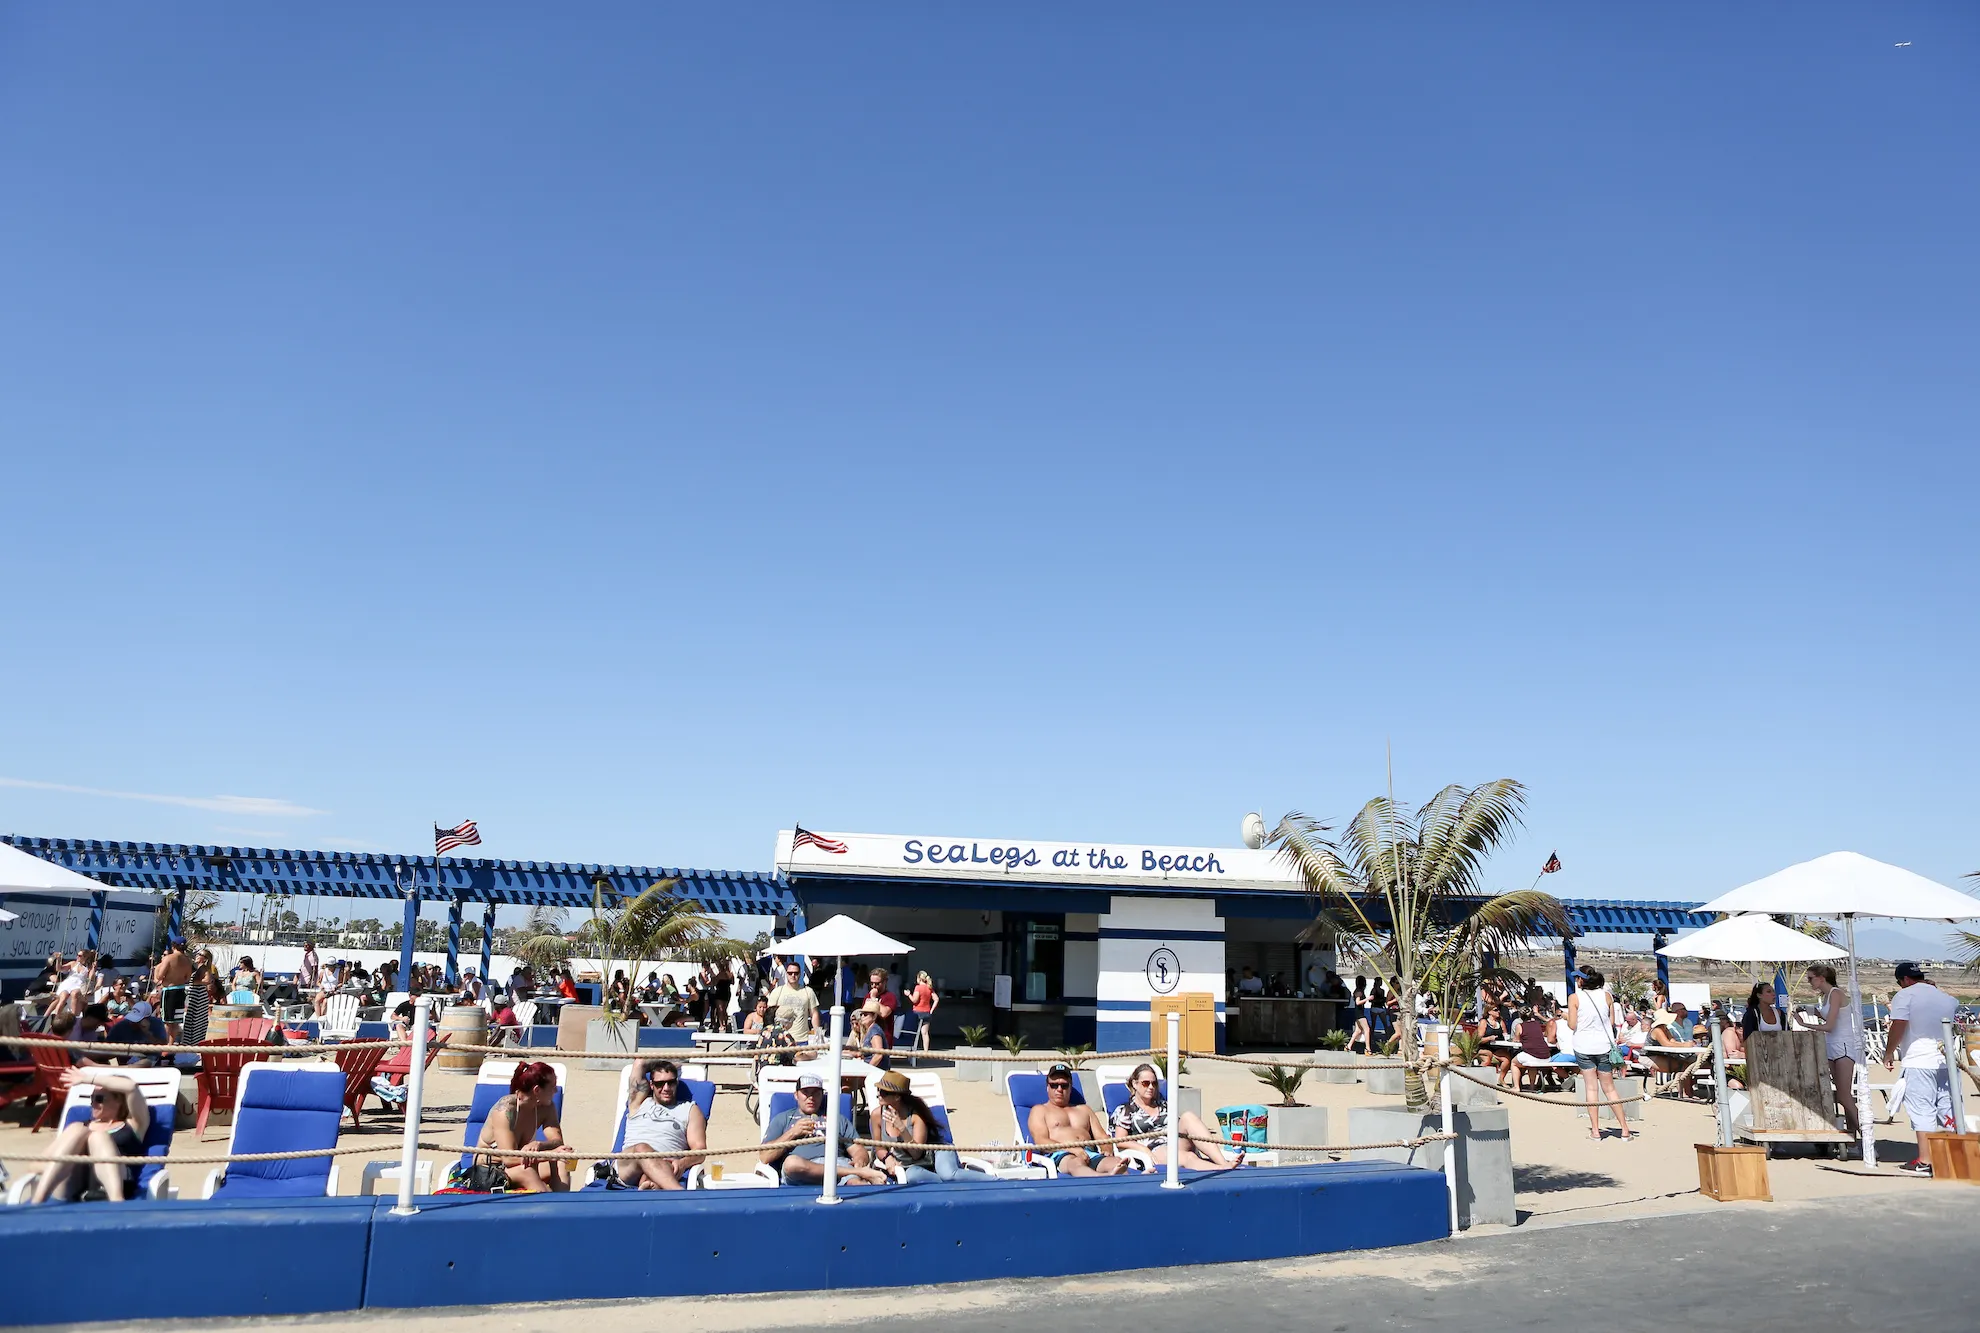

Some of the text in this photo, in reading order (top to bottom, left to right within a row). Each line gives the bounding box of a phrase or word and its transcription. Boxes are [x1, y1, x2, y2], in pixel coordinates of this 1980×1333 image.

[903, 839, 1225, 874] SeaLegs at the Beach
[20, 908, 61, 932] enough
[66, 910, 78, 931] to
[115, 916, 137, 934] wine
[10, 939, 31, 958] you
[38, 939, 56, 955] are
